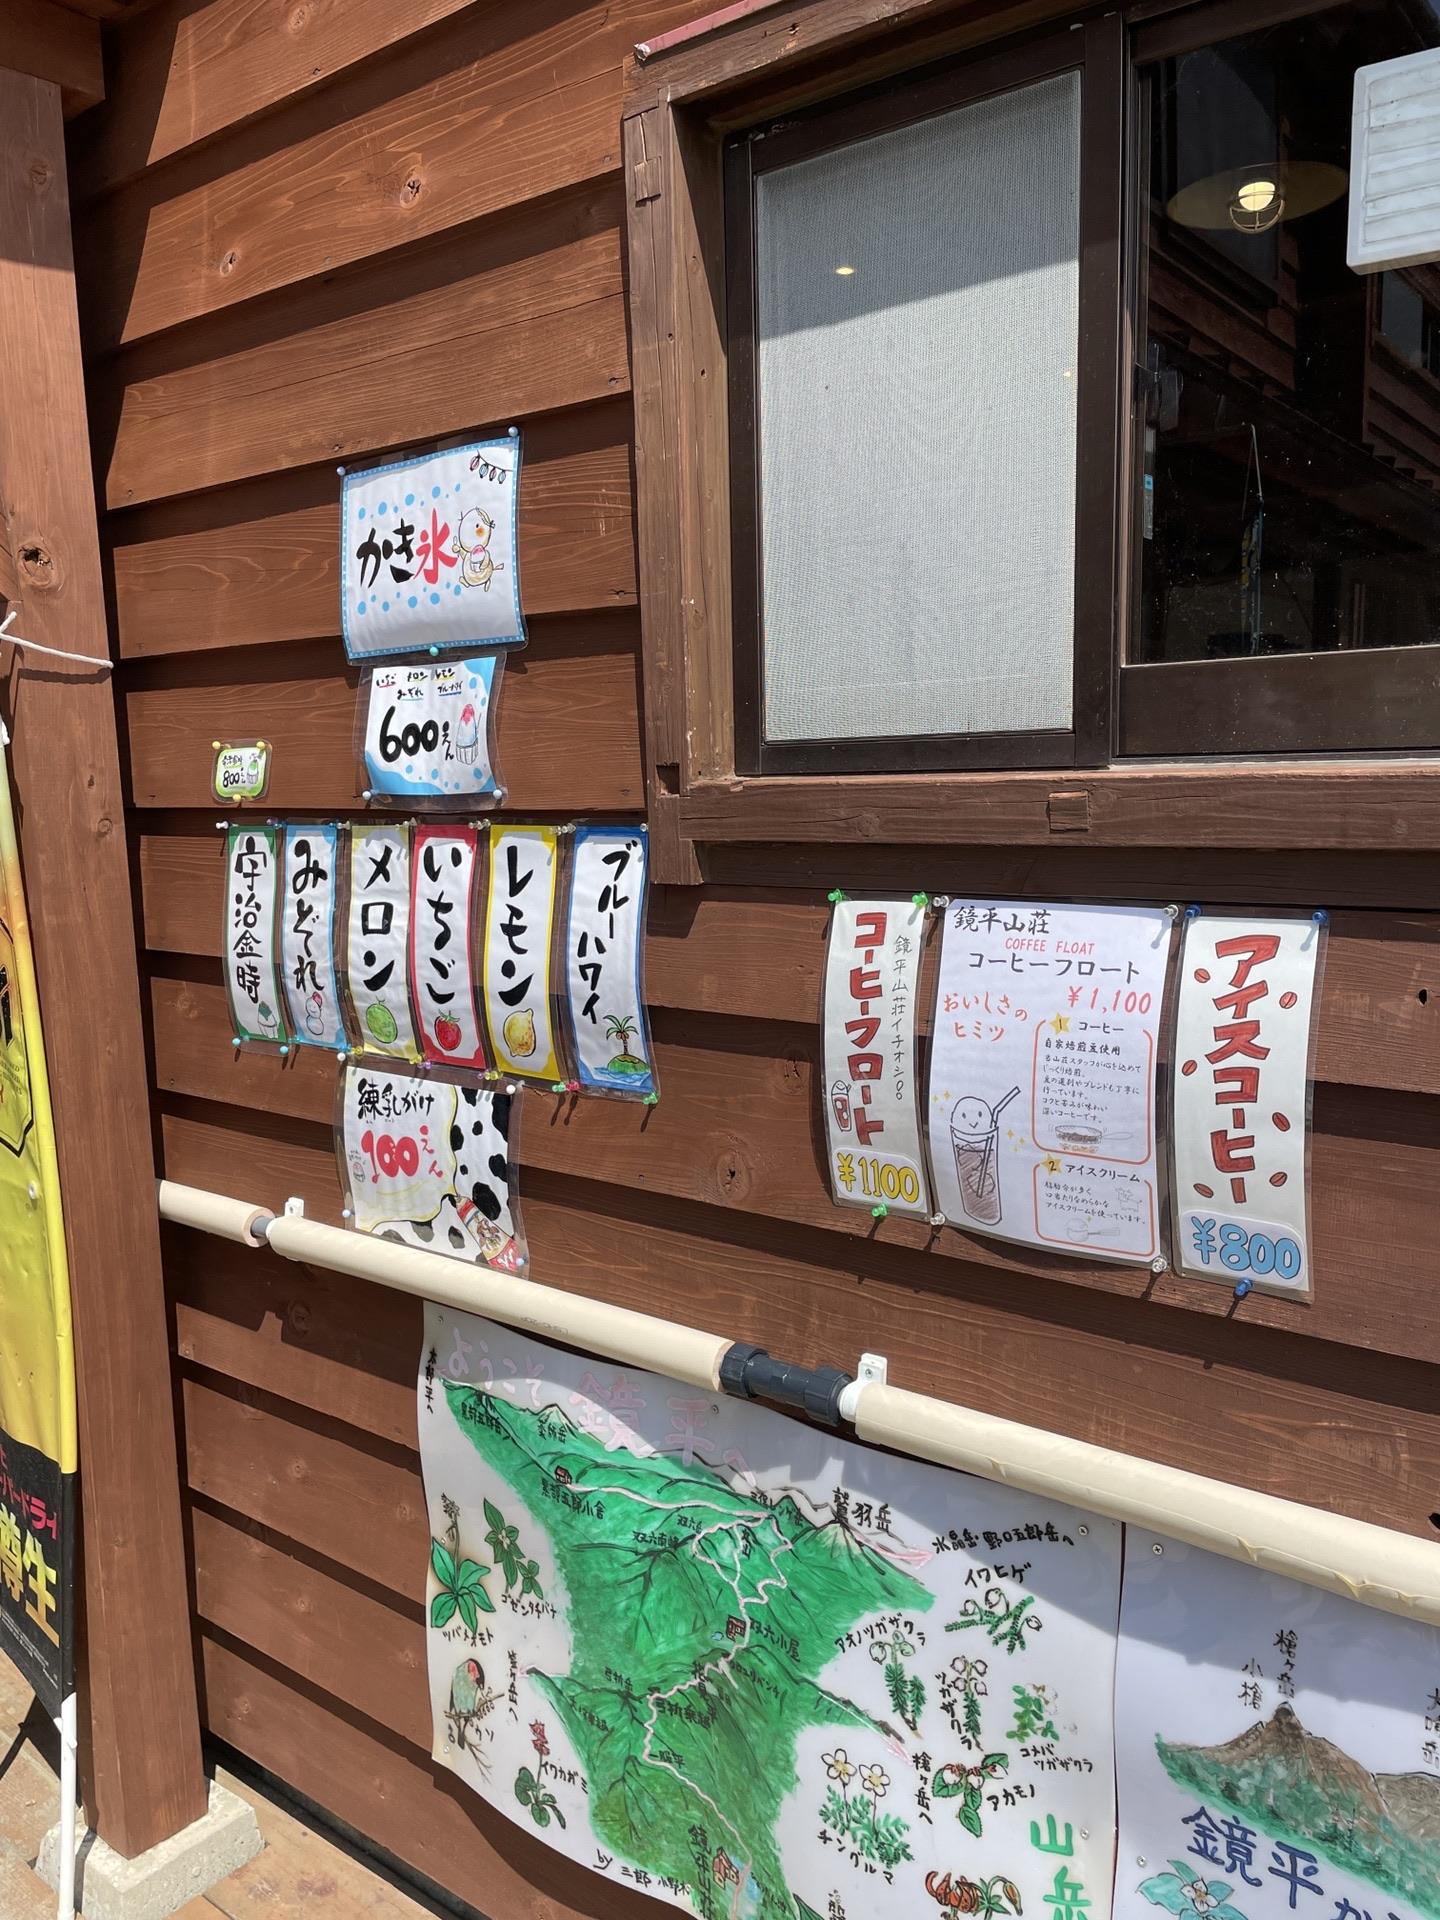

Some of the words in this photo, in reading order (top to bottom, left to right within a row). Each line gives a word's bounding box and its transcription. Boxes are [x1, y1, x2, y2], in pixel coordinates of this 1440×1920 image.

[356, 508, 458, 588] かき氷
[232, 836, 268, 1004] 宇治金時
[361, 845, 395, 992] メロン
[423, 845, 462, 1004] いちご
[498, 845, 534, 1006] レモン
[954, 906, 1051, 935] 鏡平山荘
[969, 953, 1140, 984] コーヒーフロート
[1005, 938, 1046, 952] COFFEE
[1056, 941, 1095, 955] FLOAT
[845, 911, 888, 1146] コーヒーフロート
[944, 992, 1028, 1021] おいしさの
[1079, 1022, 1124, 1034] コーヒー
[954, 1021, 1005, 1041] ヒミツ
[1205, 934, 1281, 1204] アイスコーヒー
[357, 1076, 434, 1120] 練乳がけ
[837, 1152, 919, 1204] ¥1100
[1048, 1160, 1057, 1172] 2
[1065, 1164, 1140, 1182] アイスクリーム
[1191, 1216, 1300, 1280] ¥800
[964, 1561, 1032, 1589] イワヒゲ
[986, 1784, 1036, 1811] アカモノ
